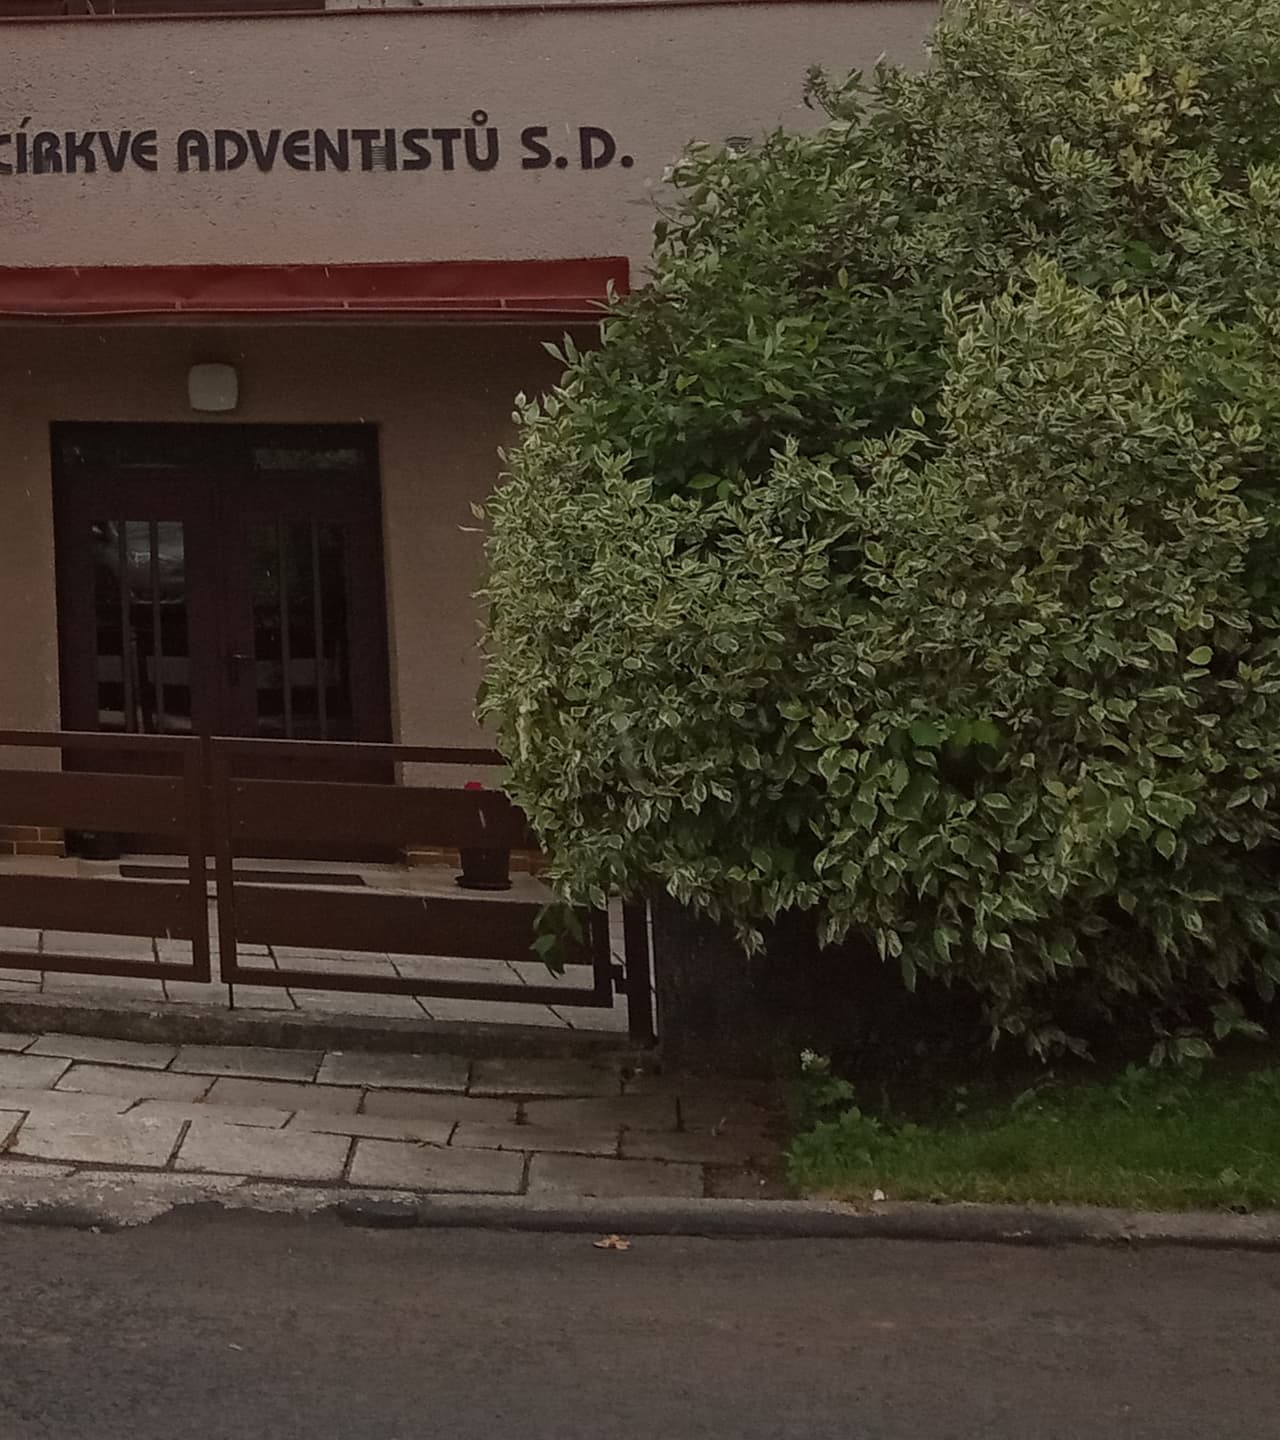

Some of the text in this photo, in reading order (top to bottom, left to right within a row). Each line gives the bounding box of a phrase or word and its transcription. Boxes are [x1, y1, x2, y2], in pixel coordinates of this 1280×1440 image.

[177, 109, 498, 172] ADVENTISTŮ
[520, 126, 569, 170] S.
[579, 126, 635, 170] D.
